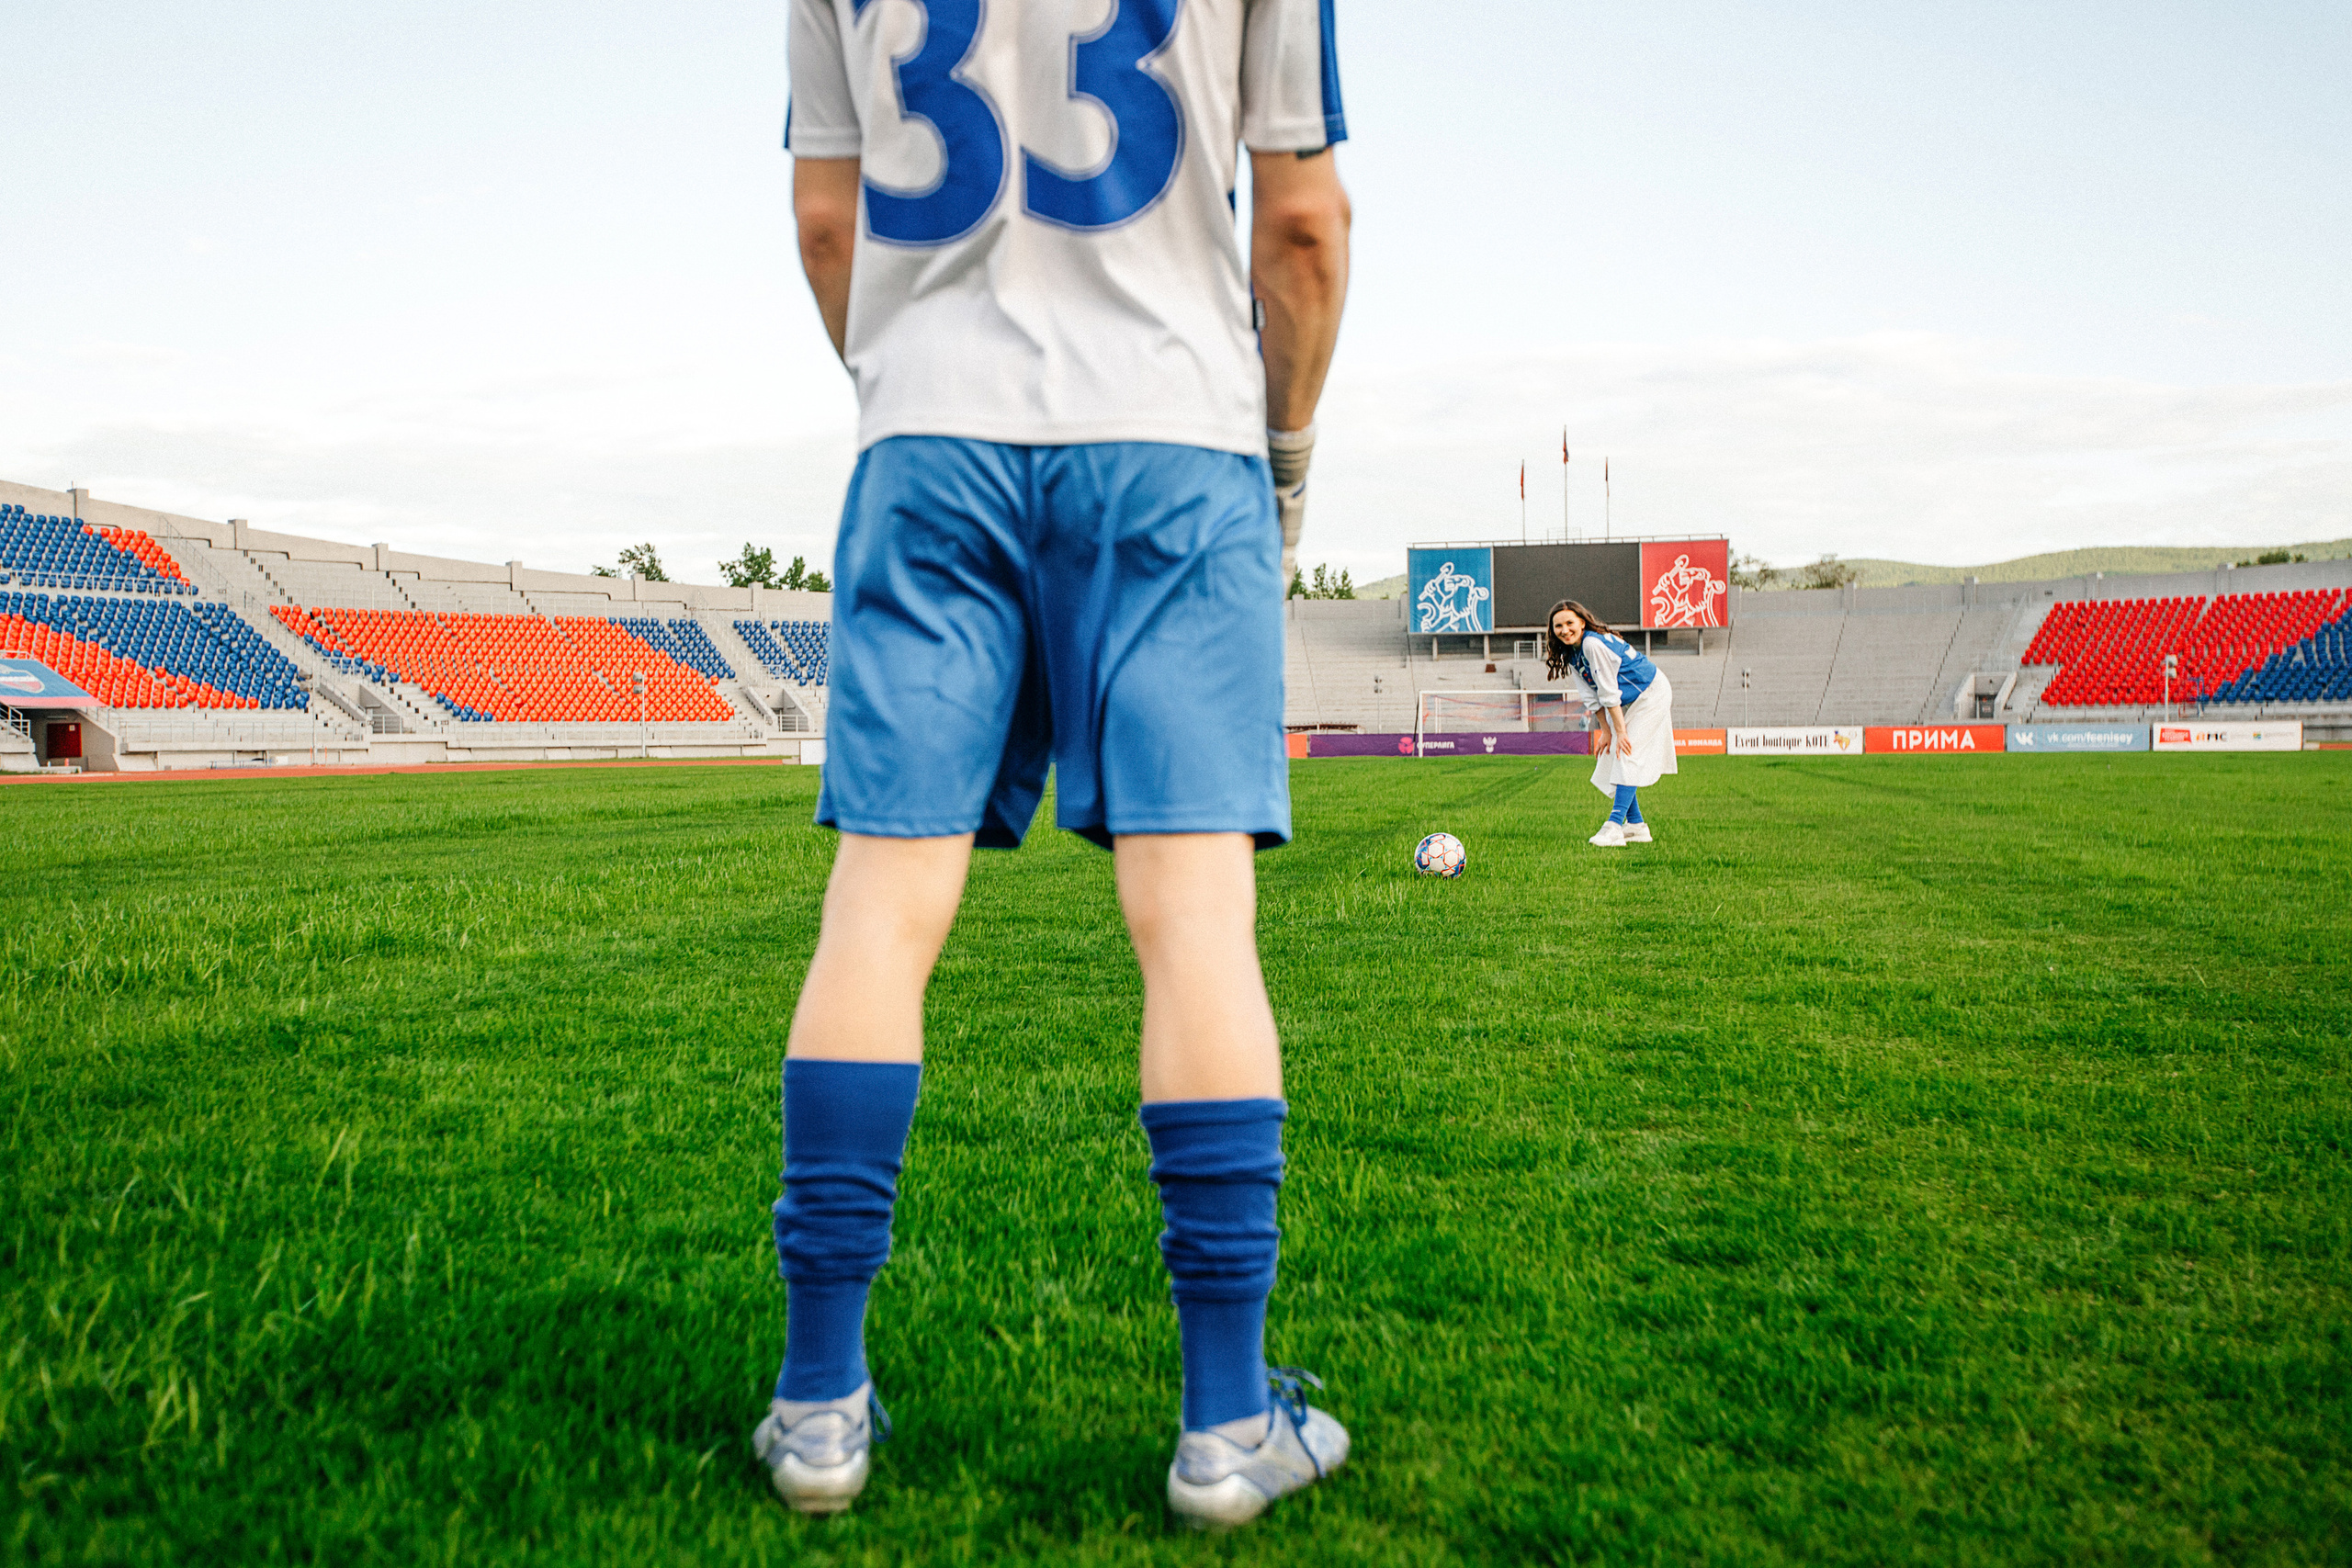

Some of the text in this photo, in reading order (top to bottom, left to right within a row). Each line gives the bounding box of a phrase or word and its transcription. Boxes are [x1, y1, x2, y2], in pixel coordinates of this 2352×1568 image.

[853, 0, 1187, 248] 33
[1736, 734, 1759, 748] Event
[1762, 734, 1802, 750] boutique
[1893, 729, 1975, 750] ПРИМА
